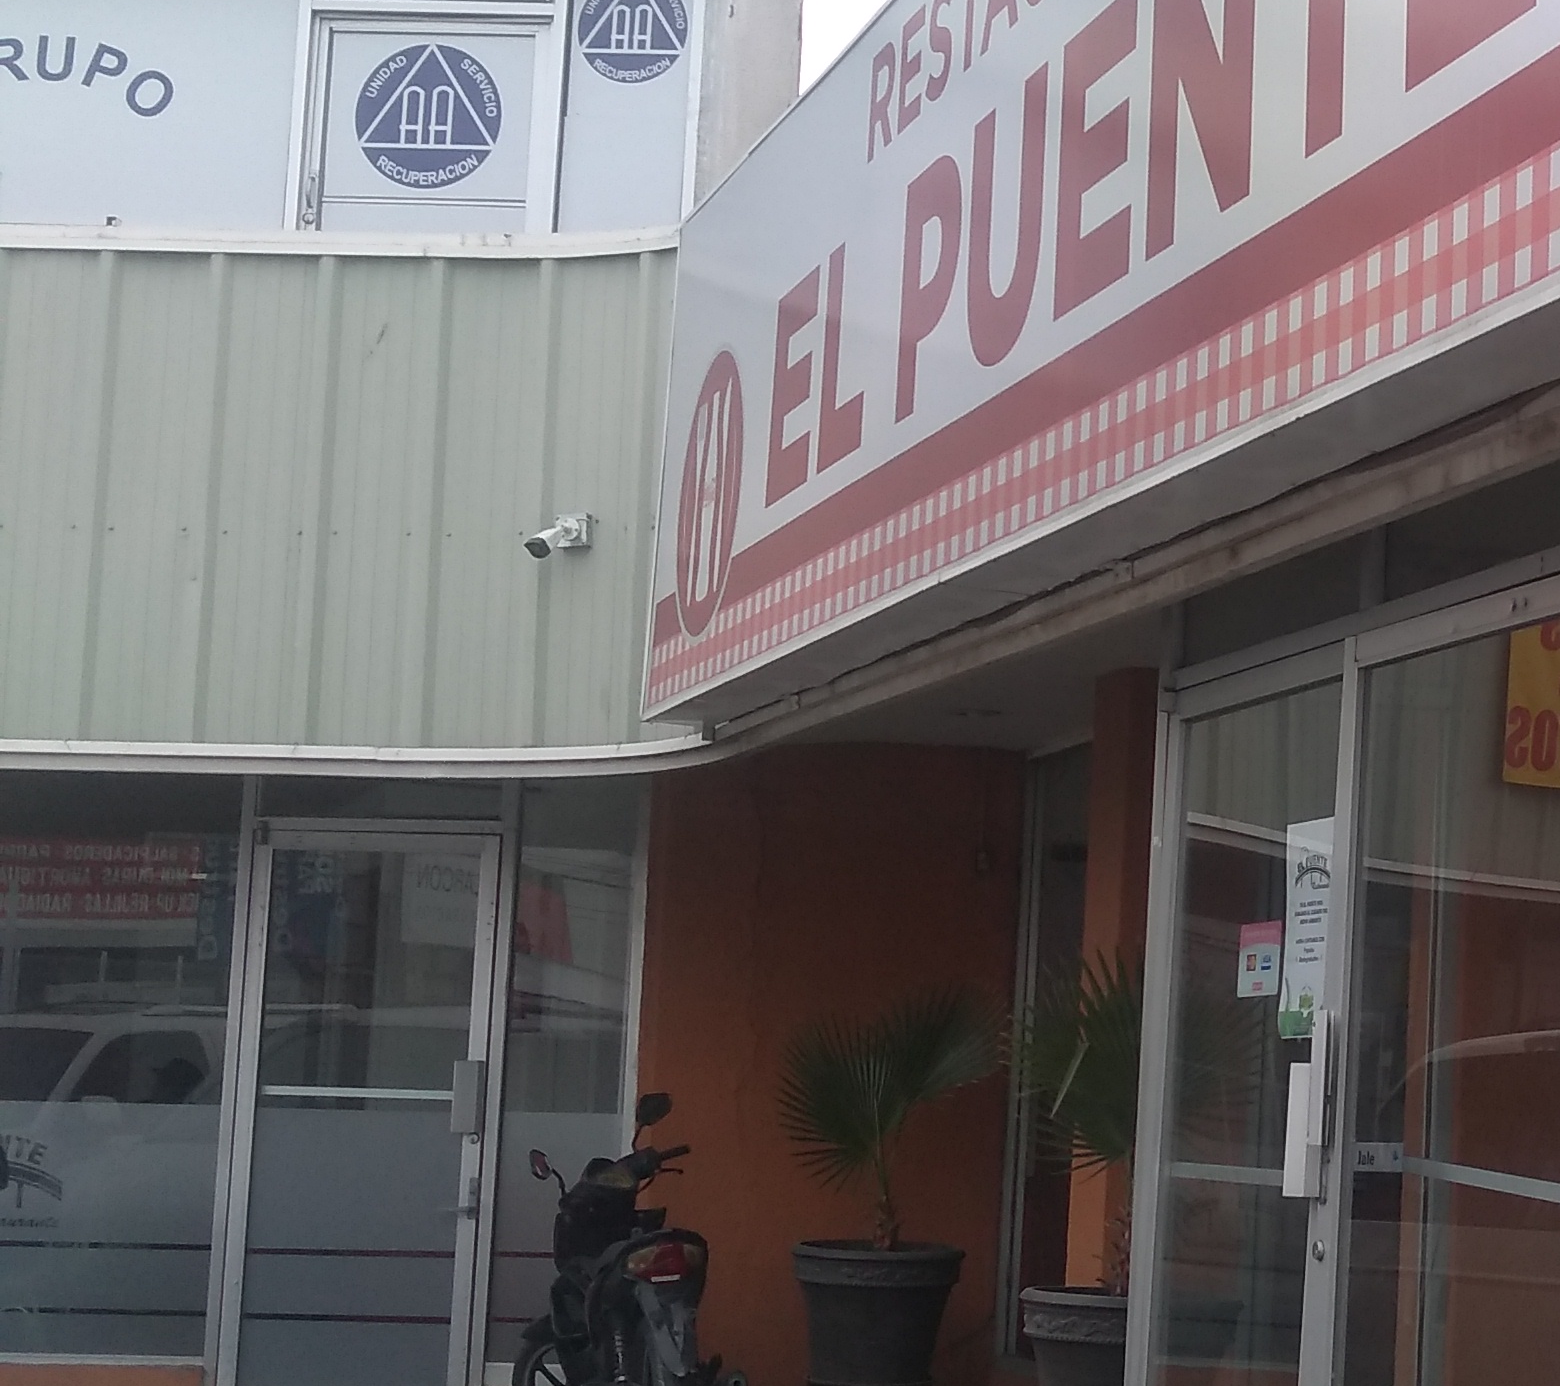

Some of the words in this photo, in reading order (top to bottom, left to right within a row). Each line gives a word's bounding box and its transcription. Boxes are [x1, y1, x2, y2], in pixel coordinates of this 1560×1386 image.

[611, 4, 653, 50] AA
[365, 55, 407, 98] UNIDAD
[460, 58, 497, 117] SERVICIO
[593, 57, 671, 81] RECUPERACION
[399, 85, 455, 145] AA
[376, 153, 479, 185] RECUPERACION
[765, 242, 864, 508] EL
